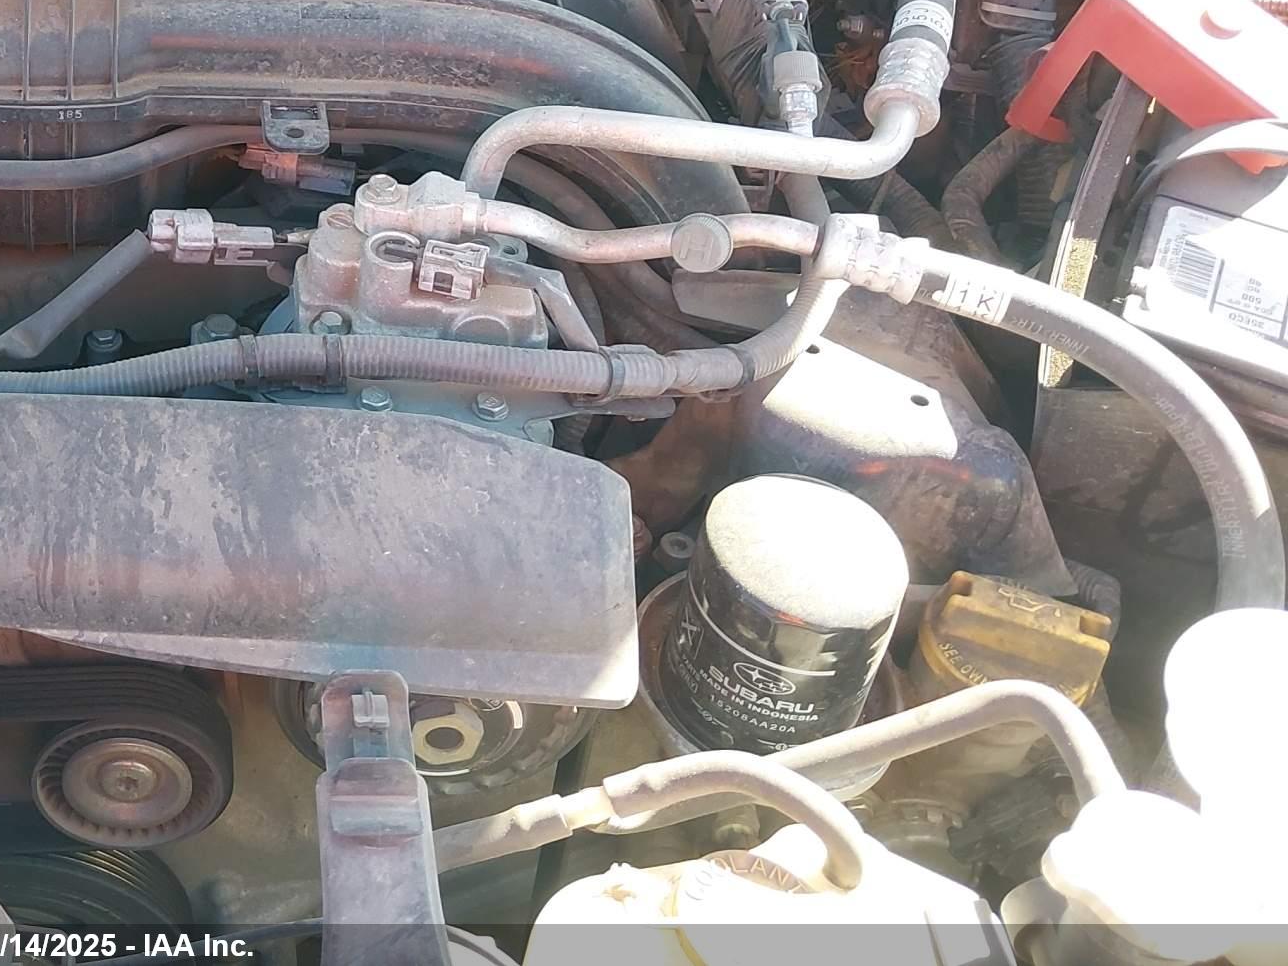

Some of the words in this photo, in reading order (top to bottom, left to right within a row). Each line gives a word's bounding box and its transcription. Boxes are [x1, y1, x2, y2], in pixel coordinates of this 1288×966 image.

[938, 642, 959, 667] SEE
[699, 668, 730, 695] MADE
[731, 695, 746, 706] IN
[747, 702, 819, 722] INDONESIA
[709, 665, 815, 714] SUBARU
